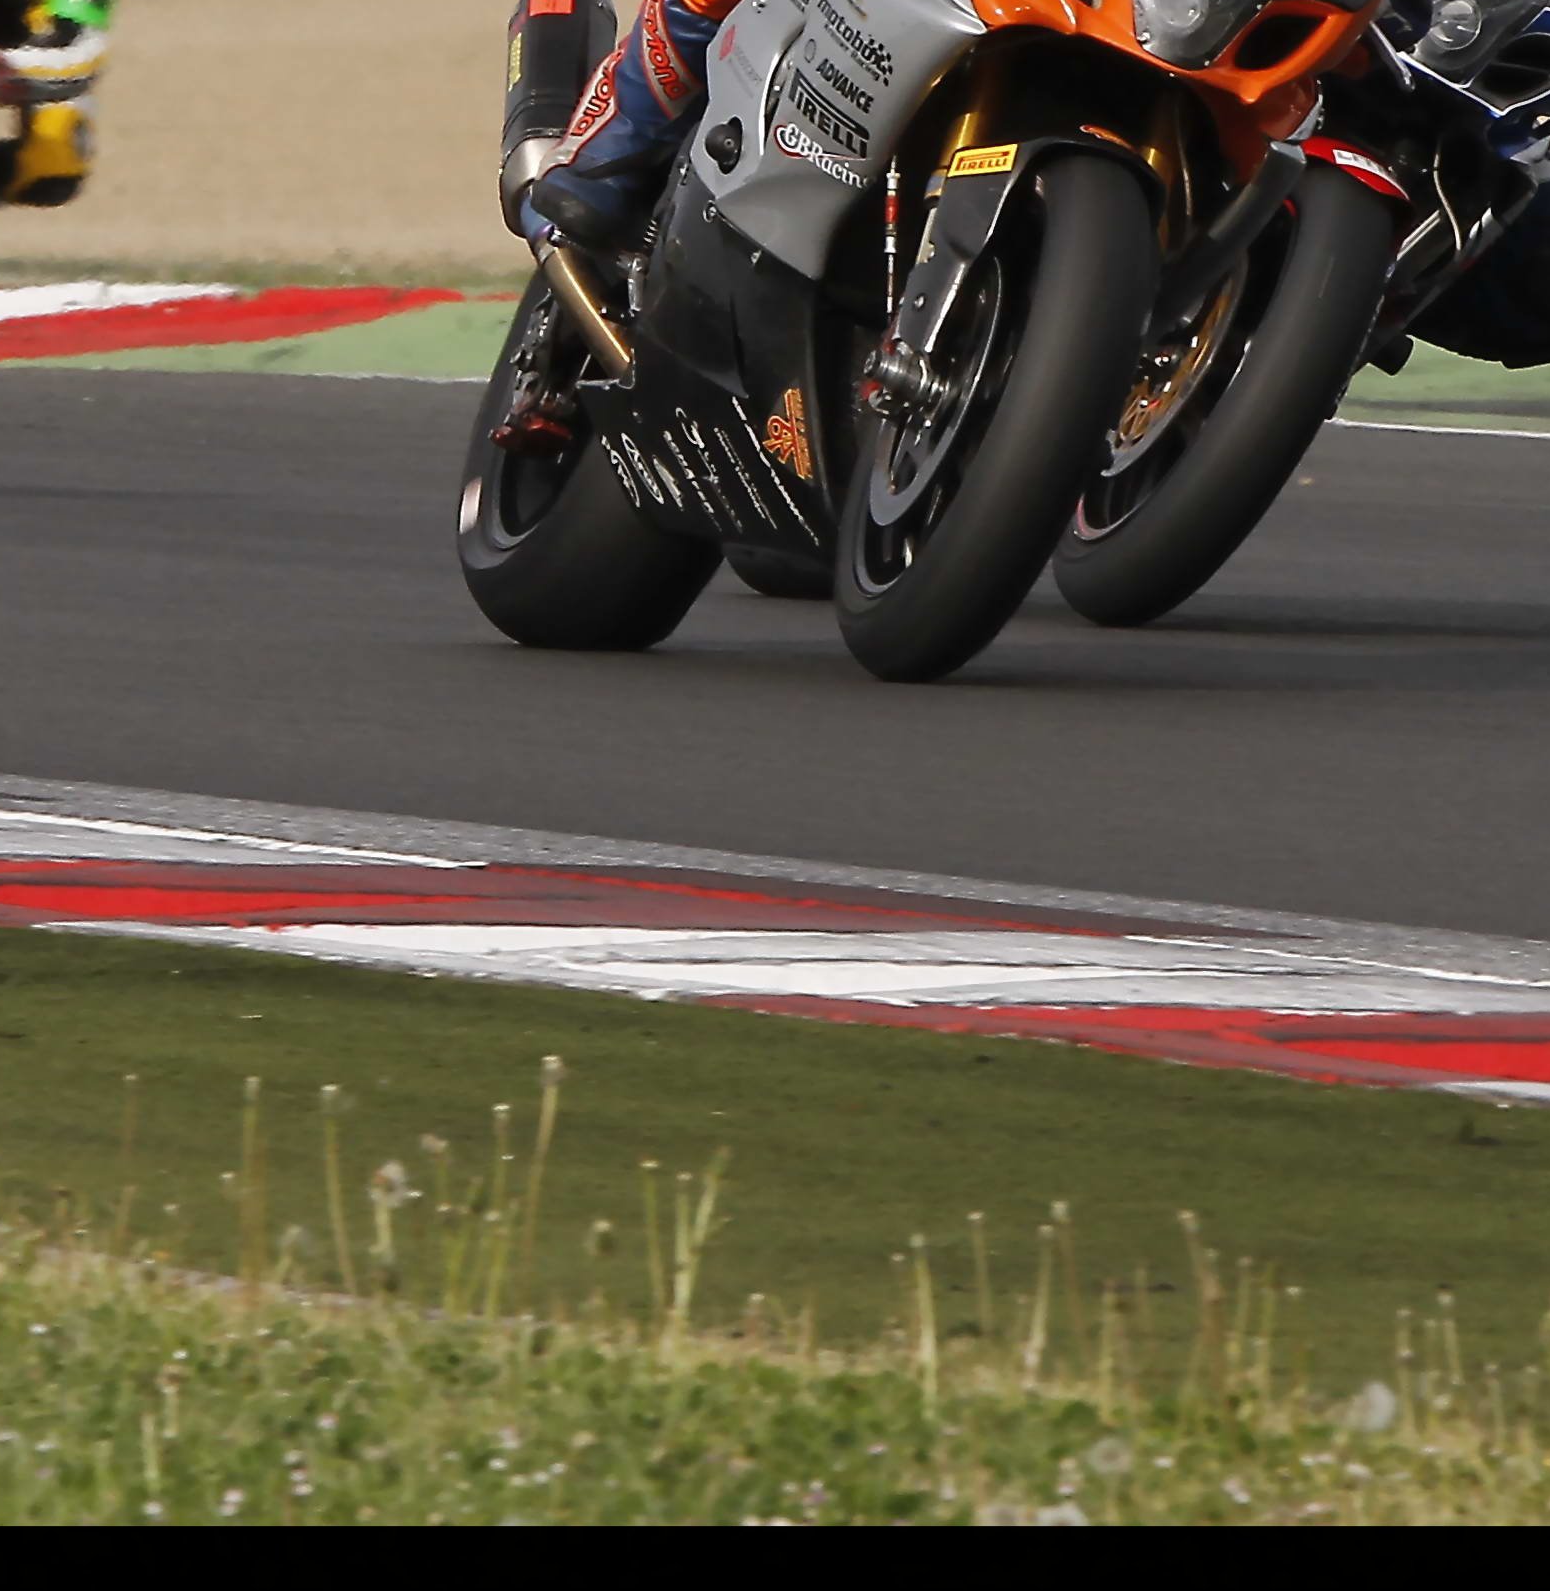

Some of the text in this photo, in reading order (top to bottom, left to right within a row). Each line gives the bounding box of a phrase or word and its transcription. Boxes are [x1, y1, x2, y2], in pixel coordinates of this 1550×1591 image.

[789, 68, 870, 158] PIRELLI
[816, 58, 874, 114] ADVANCE
[955, 151, 1010, 171] PIRELLI
